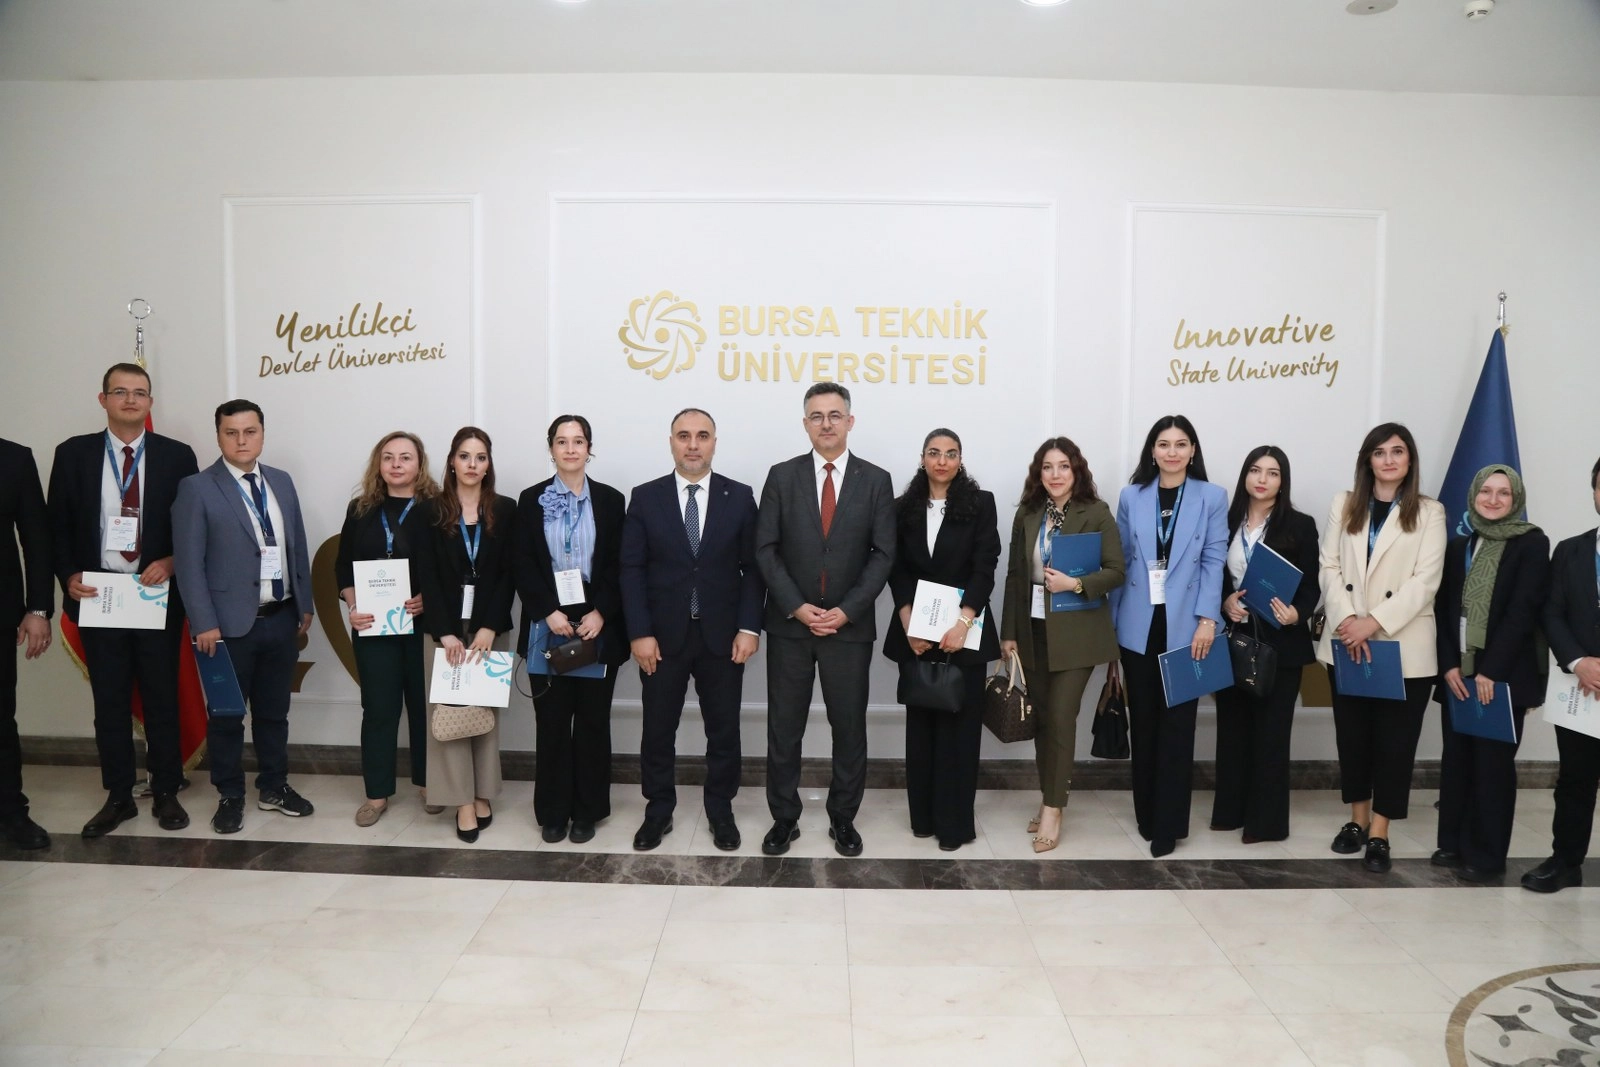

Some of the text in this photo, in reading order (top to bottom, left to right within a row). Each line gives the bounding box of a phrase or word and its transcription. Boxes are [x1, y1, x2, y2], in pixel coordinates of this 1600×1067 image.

[275, 302, 417, 353] Yenilikçi
[718, 300, 988, 339] BURSA TEKNİK
[1173, 313, 1336, 350] Innovative
[258, 342, 447, 378] Devlet Üniversitesi
[717, 343, 987, 385] ÜNİVERSİTESİ
[1167, 352, 1340, 388] State University
